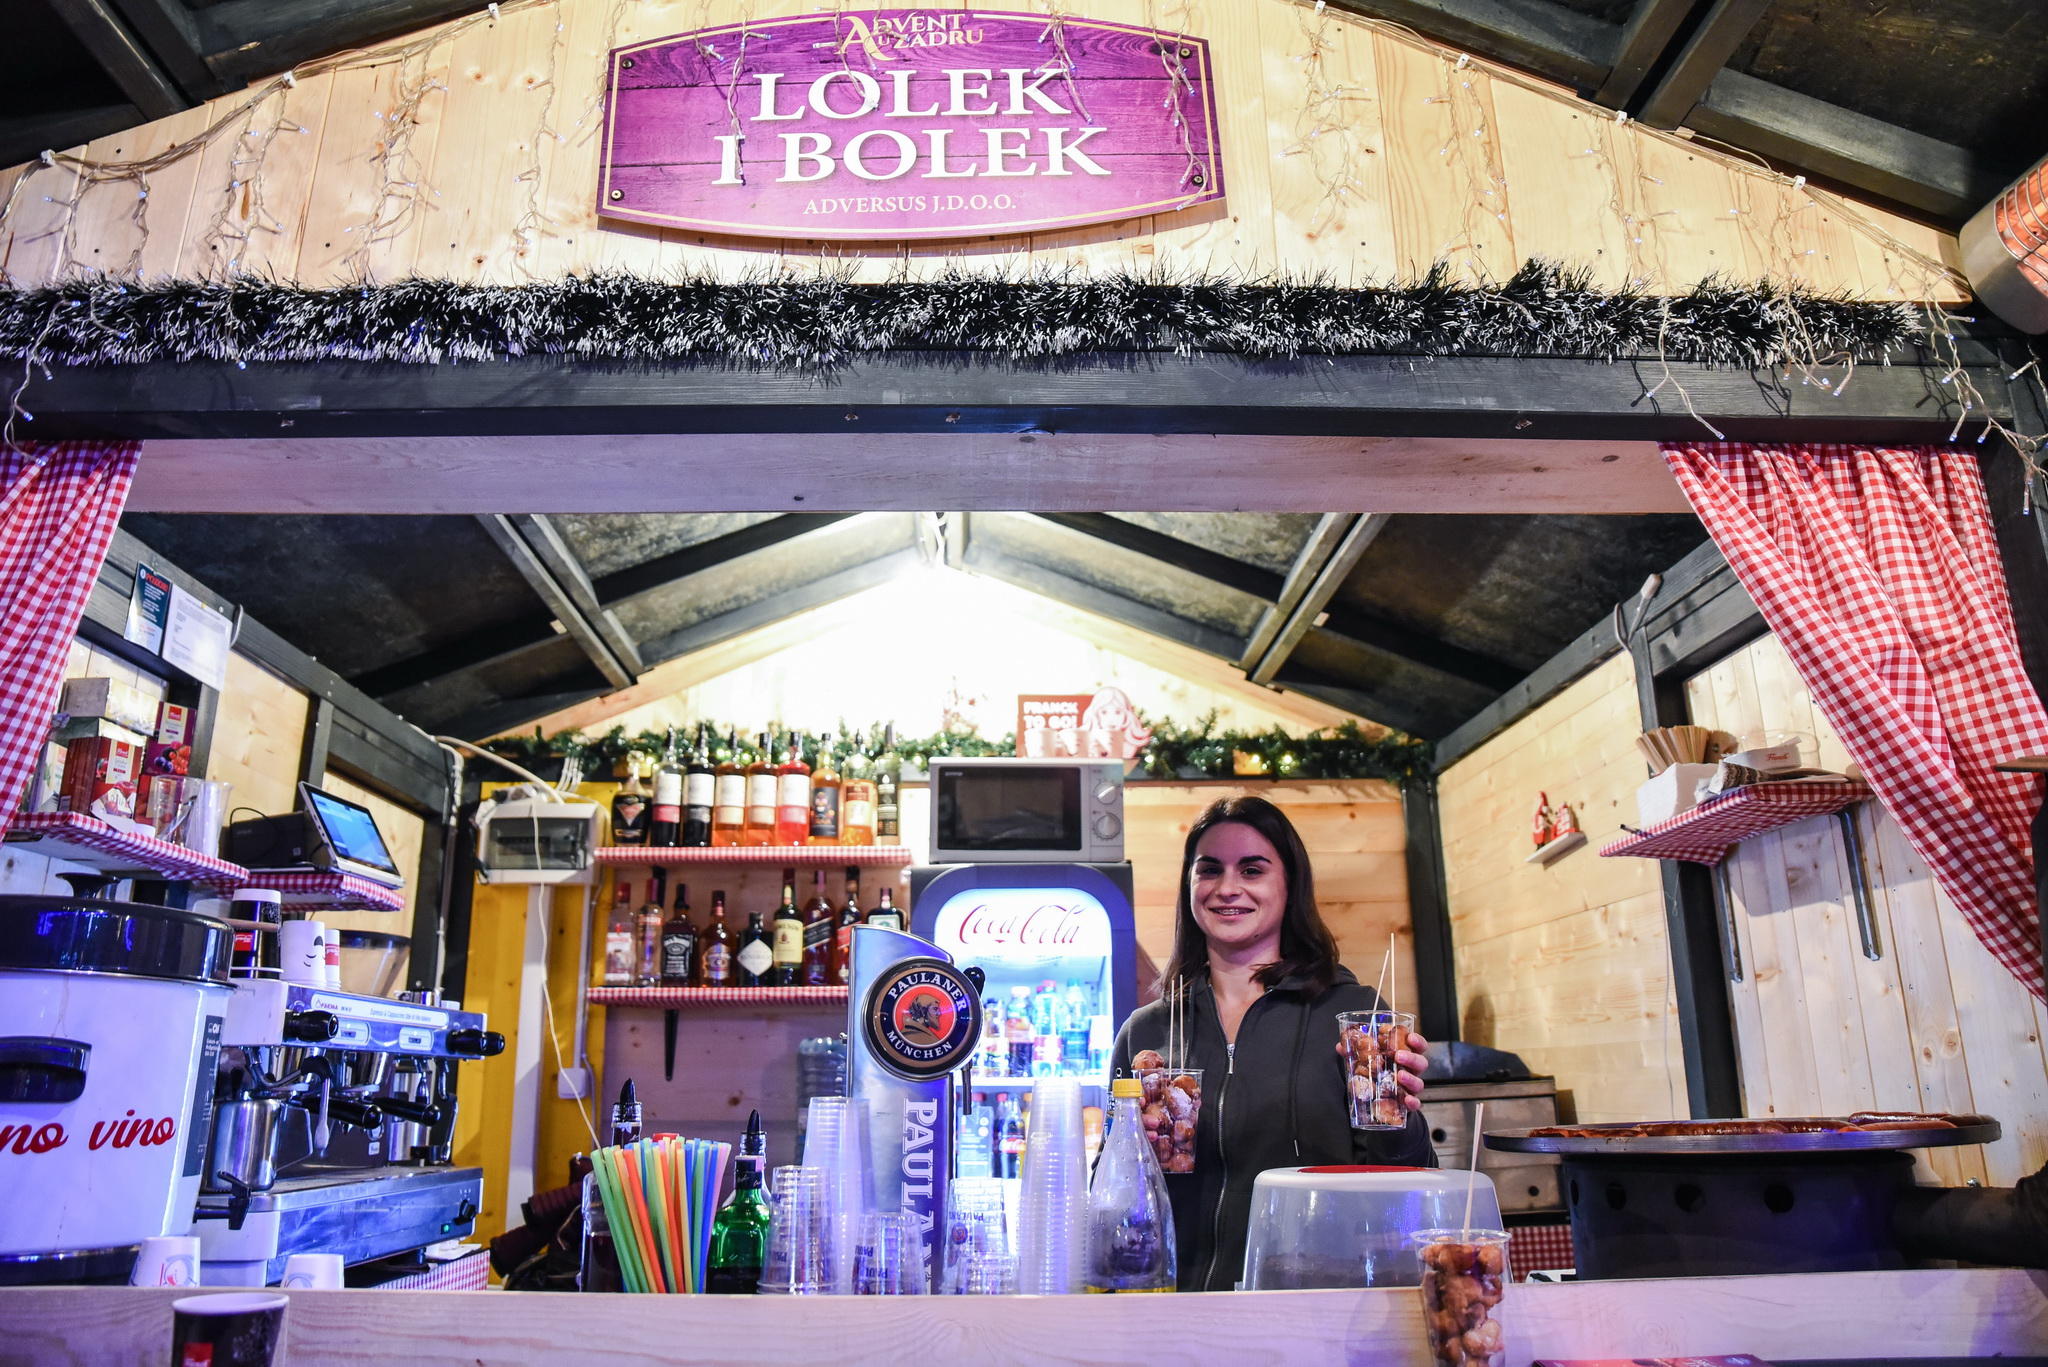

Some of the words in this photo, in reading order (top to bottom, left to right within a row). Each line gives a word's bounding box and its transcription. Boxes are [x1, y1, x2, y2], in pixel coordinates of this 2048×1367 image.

[893, 29, 984, 49] ZADRU
[750, 68, 1072, 122] LOLEK
[711, 135, 745, 185] I
[775, 127, 1112, 183] BOLEK
[803, 197, 926, 215] ADVERSUS
[931, 194, 1017, 212] J.D.O.O.
[1023, 715, 1046, 729] TO
[888, 972, 968, 1012] PAULANER
[887, 1030, 953, 1059] MÜNCHEN
[88, 1109, 176, 1151] vino
